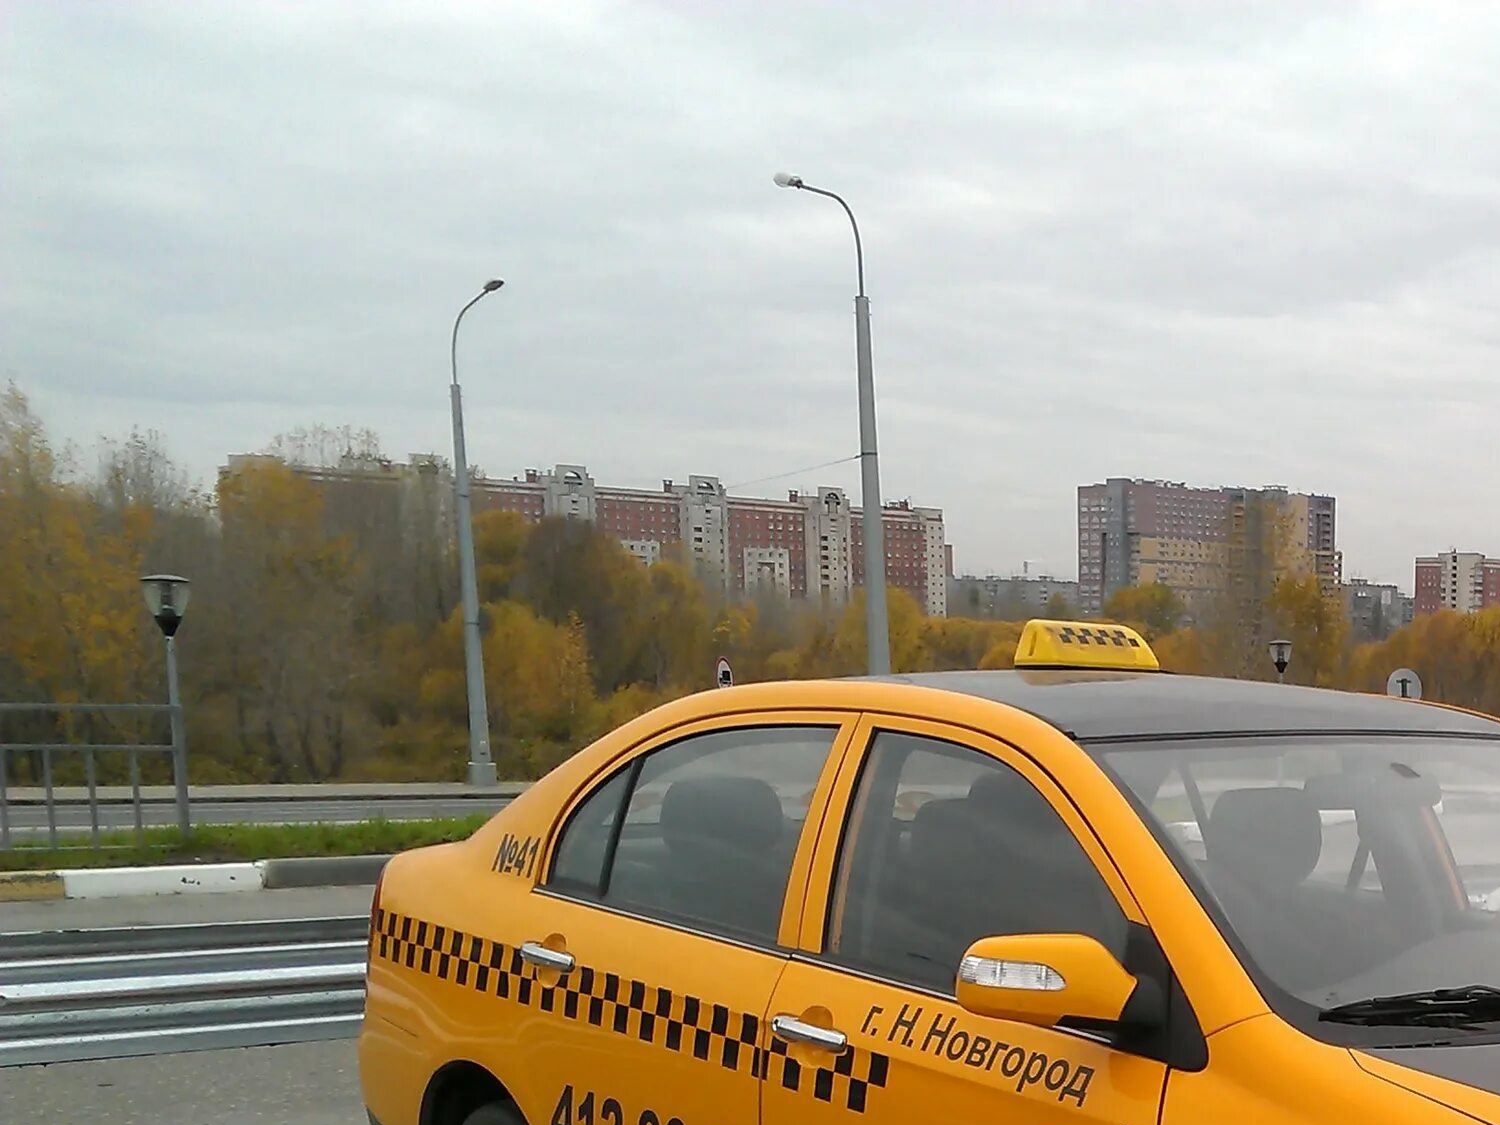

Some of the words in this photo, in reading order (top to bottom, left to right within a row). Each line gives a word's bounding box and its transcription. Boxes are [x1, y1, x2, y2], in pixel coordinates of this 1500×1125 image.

[491, 832, 541, 879] №41
[860, 1005, 884, 1036] г.
[920, 1012, 1097, 1108] Новгород
